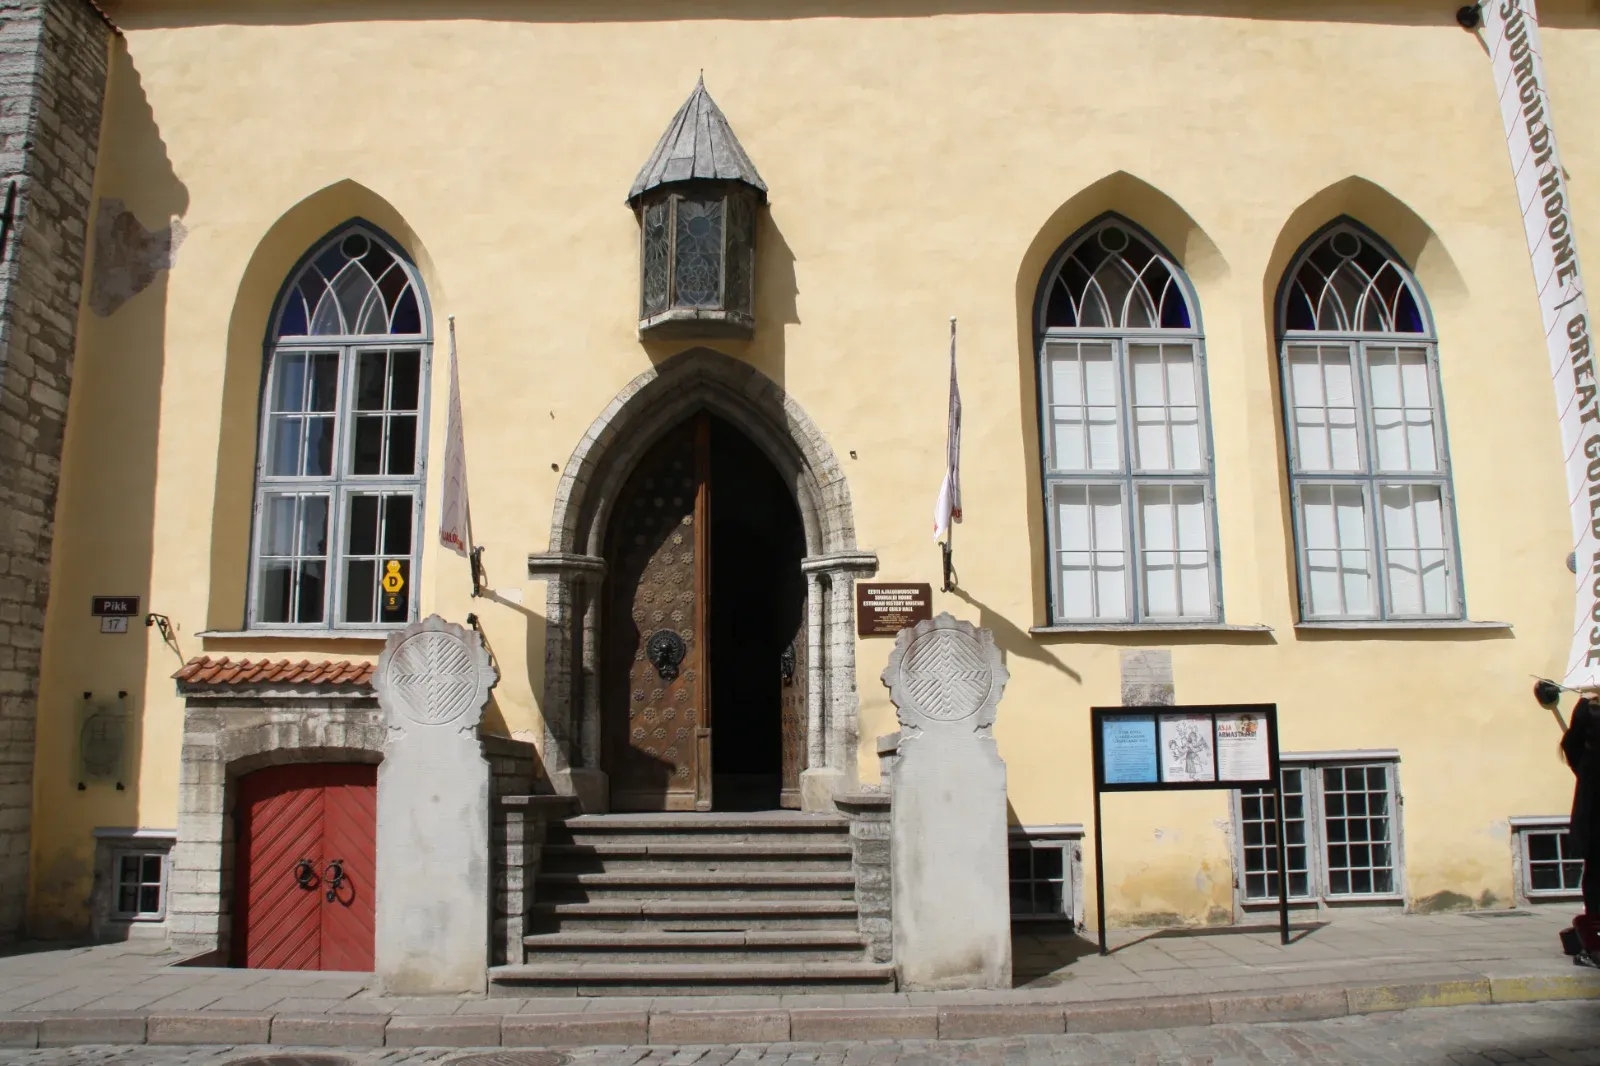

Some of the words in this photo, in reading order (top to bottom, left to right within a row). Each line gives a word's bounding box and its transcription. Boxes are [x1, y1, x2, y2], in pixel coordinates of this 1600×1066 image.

[1499, 0, 1553, 168] SUURGILDI
[1538, 165, 1578, 288] HOONE
[1566, 313, 1600, 424] GREAT
[389, 577, 398, 587] D
[103, 601, 128, 611] Pikk
[108, 619, 120, 630] 17
